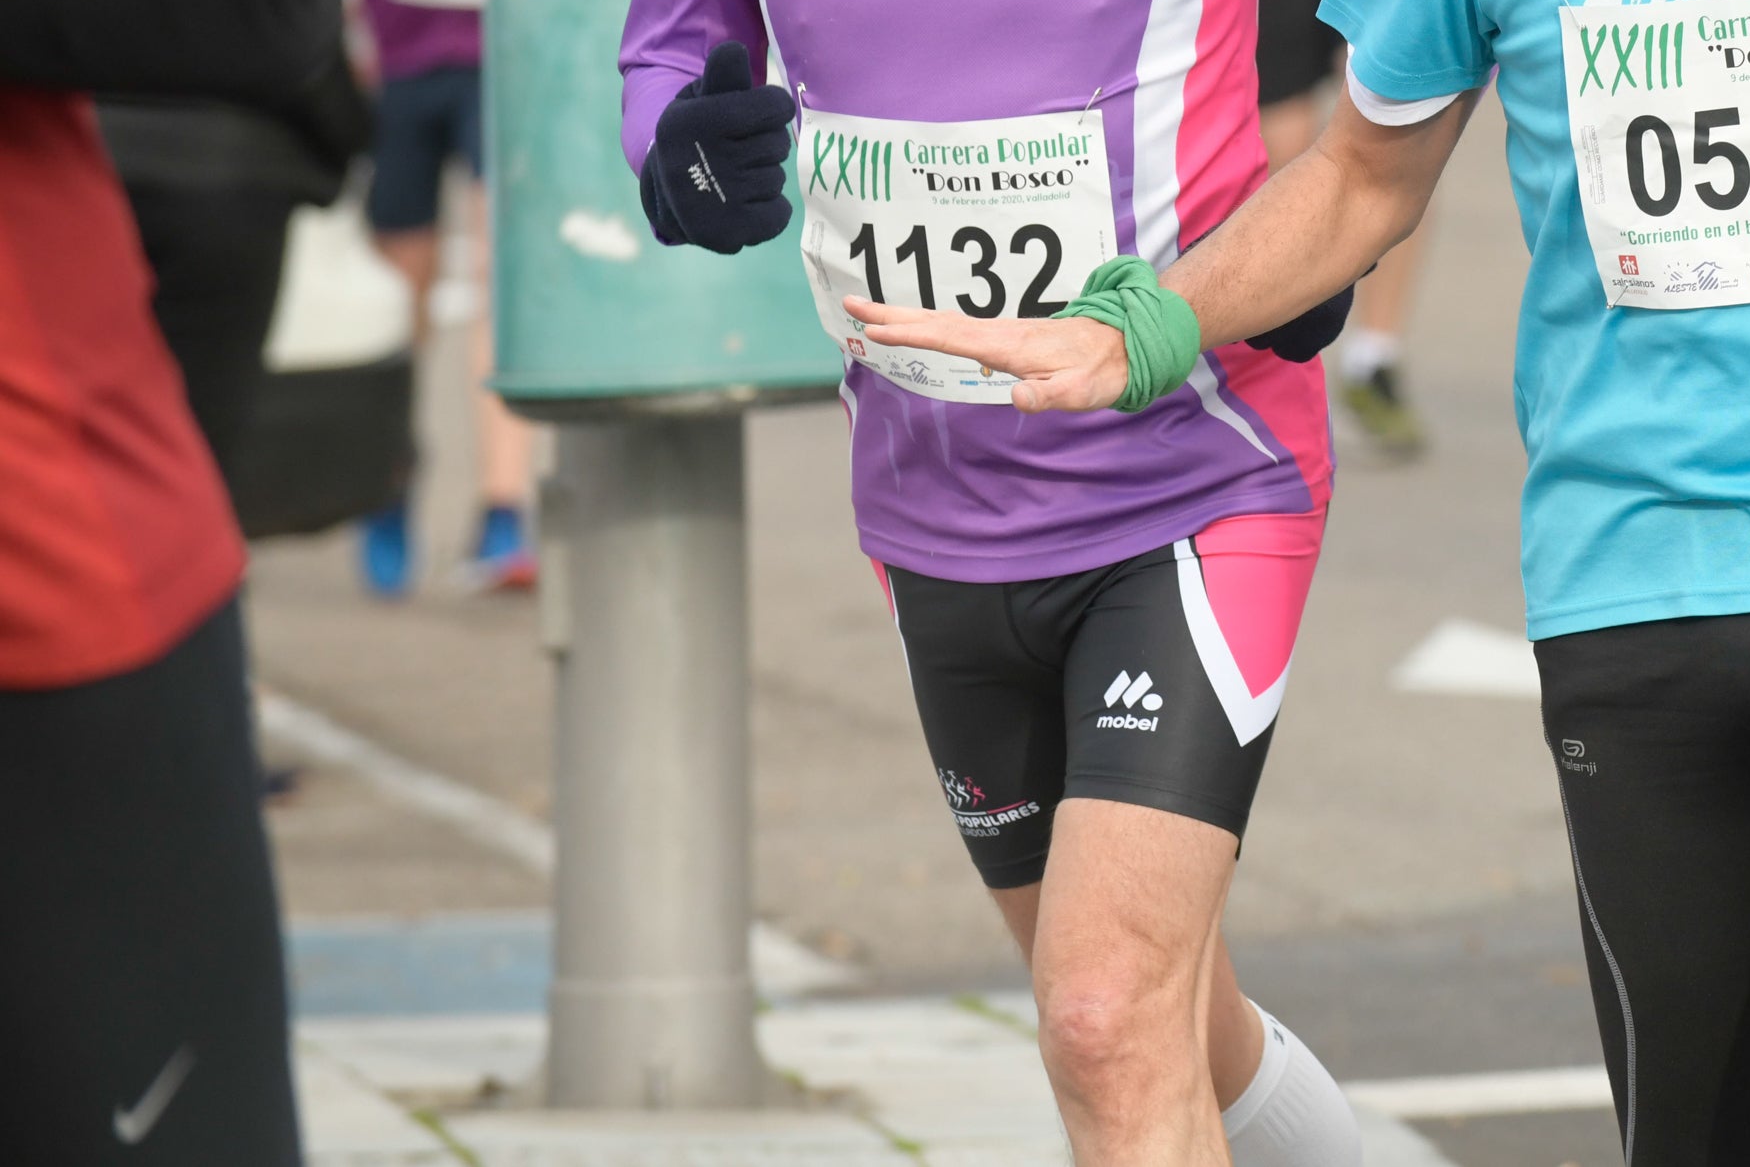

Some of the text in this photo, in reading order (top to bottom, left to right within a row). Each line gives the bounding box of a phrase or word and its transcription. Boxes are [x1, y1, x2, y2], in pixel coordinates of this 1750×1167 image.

[1580, 21, 1684, 97] XXIII
[1730, 73, 1737, 83] 9
[1738, 71, 1750, 82] de
[904, 133, 1092, 166] Carrera Popular
[809, 129, 893, 202] XXIII
[932, 196, 938, 206] 9
[939, 195, 950, 205] de
[952, 194, 986, 206] febrero
[988, 193, 999, 205] de
[1026, 190, 1071, 203] Valladolid
[1704, 225, 1721, 238] en
[1728, 220, 1740, 236] el
[850, 222, 1069, 319] 1132
[1096, 713, 1159, 732] mobel
[958, 801, 1041, 828] POPULARES
